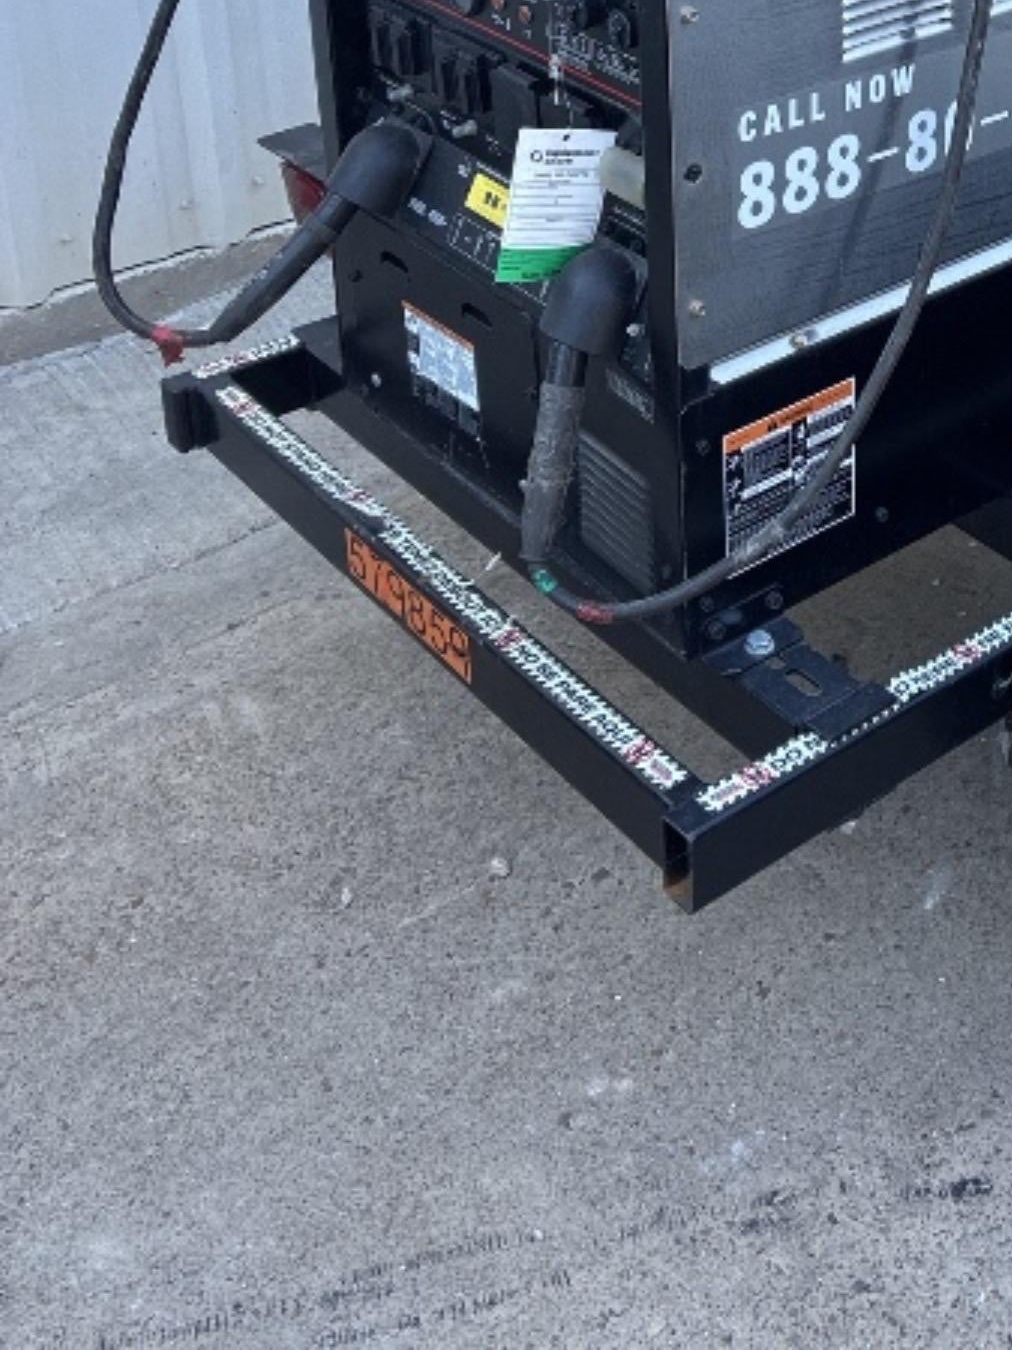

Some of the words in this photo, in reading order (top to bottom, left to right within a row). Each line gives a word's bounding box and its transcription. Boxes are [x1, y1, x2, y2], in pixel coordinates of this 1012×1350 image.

[738, 92, 826, 142] CALL
[844, 63, 917, 112] NOW
[351, 535, 469, 680] 579859
